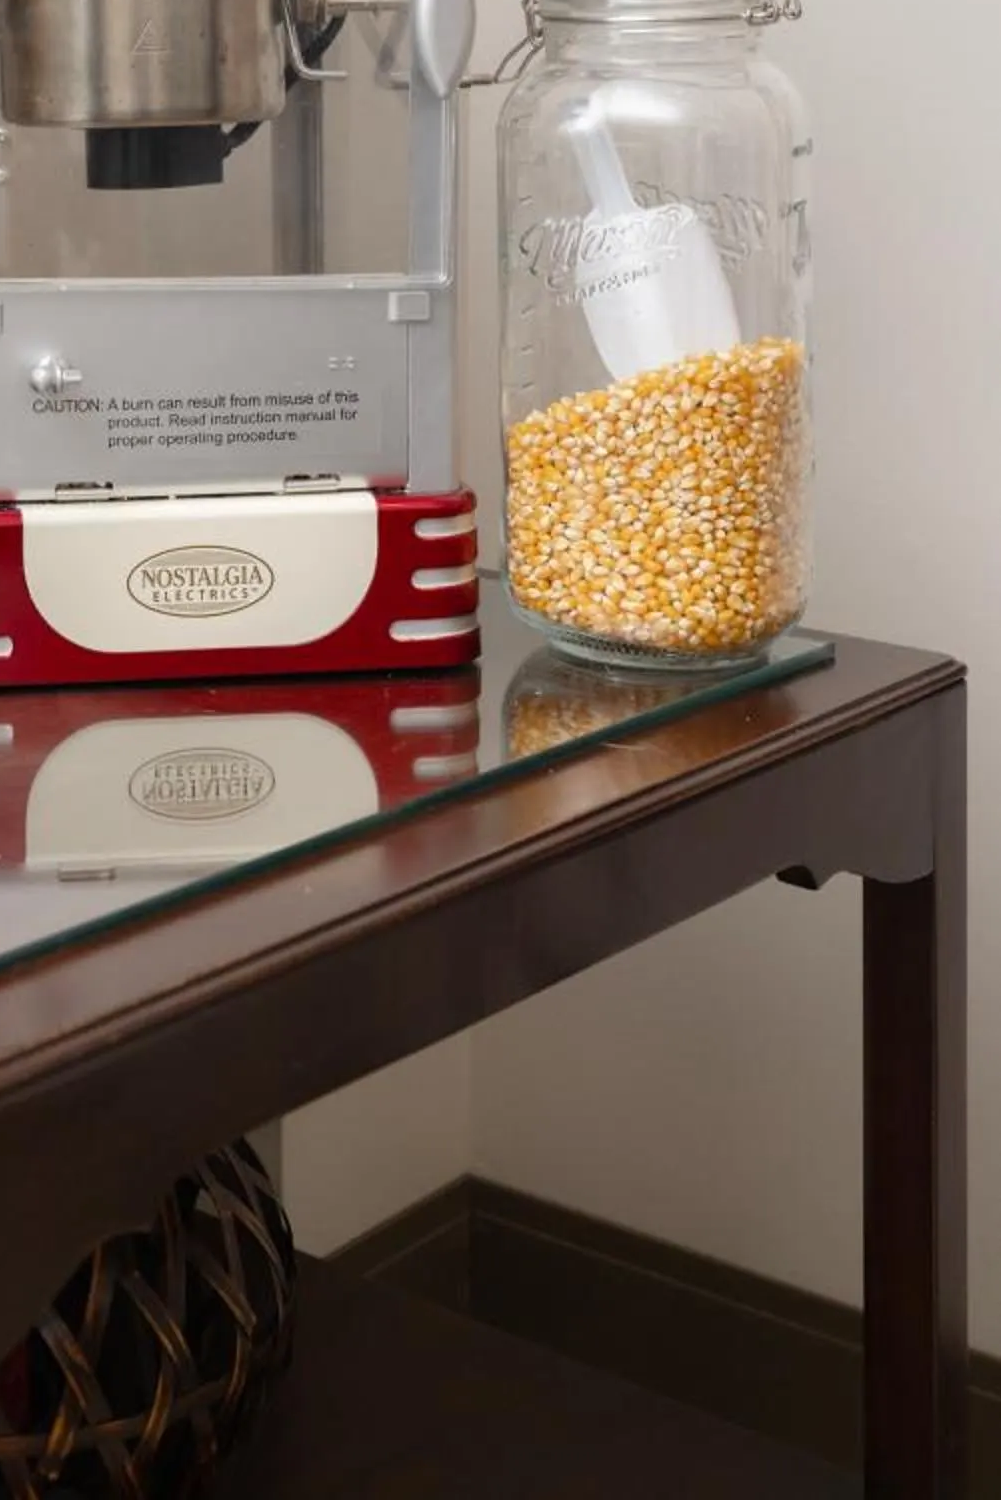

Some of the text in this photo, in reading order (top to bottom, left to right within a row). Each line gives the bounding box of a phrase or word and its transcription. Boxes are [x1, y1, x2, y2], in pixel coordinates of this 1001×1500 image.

[32, 390, 359, 414] CAUTION: A burn can result from misuse of this
[108, 408, 358, 430] product. Read instruction manual for
[108, 435, 153, 449] proper
[158, 432, 223, 447] operating
[141, 565, 264, 588] NOSTALGIA
[152, 586, 248, 602] ELECTRICS
